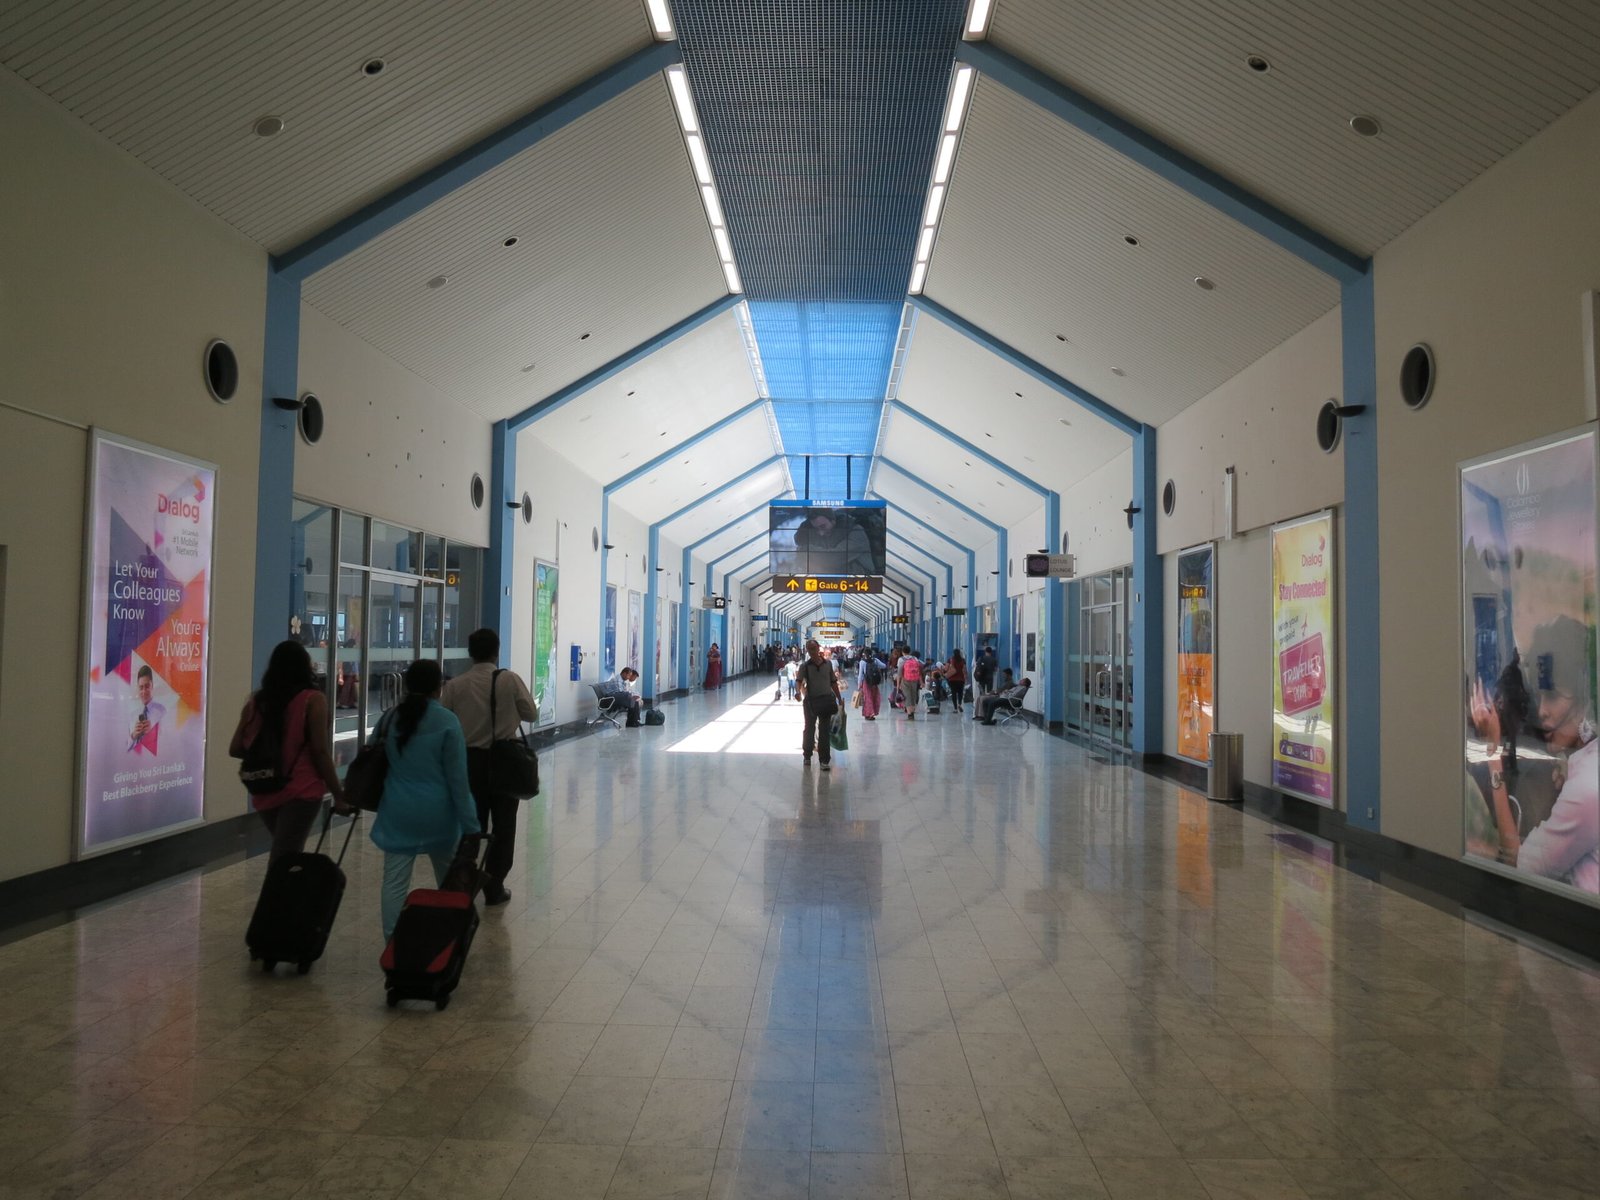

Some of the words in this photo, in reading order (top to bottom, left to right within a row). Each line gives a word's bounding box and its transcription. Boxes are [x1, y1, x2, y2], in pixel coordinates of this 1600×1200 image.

[158, 493, 200, 524] Dialog
[180, 536, 199, 547] Mobile
[175, 546, 199, 557] Network
[1301, 553, 1323, 567] Dialog
[115, 560, 133, 576] Let
[135, 562, 159, 579] Your
[113, 580, 181, 606] Colleagues
[819, 581, 839, 590] Gate
[1279, 583, 1292, 601] Stay
[1292, 578, 1327, 599] Connected
[113, 604, 145, 620] Know
[171, 618, 201, 635] You're
[156, 636, 200, 661] Always
[180, 662, 200, 672] Online
[113, 769, 139, 783] Giving
[139, 767, 152, 778] You
[152, 764, 161, 777] Sri
[162, 762, 186, 774] Lanka's
[103, 789, 119, 801] Best
[120, 782, 158, 798] Blackberry
[159, 776, 193, 791] Experience
